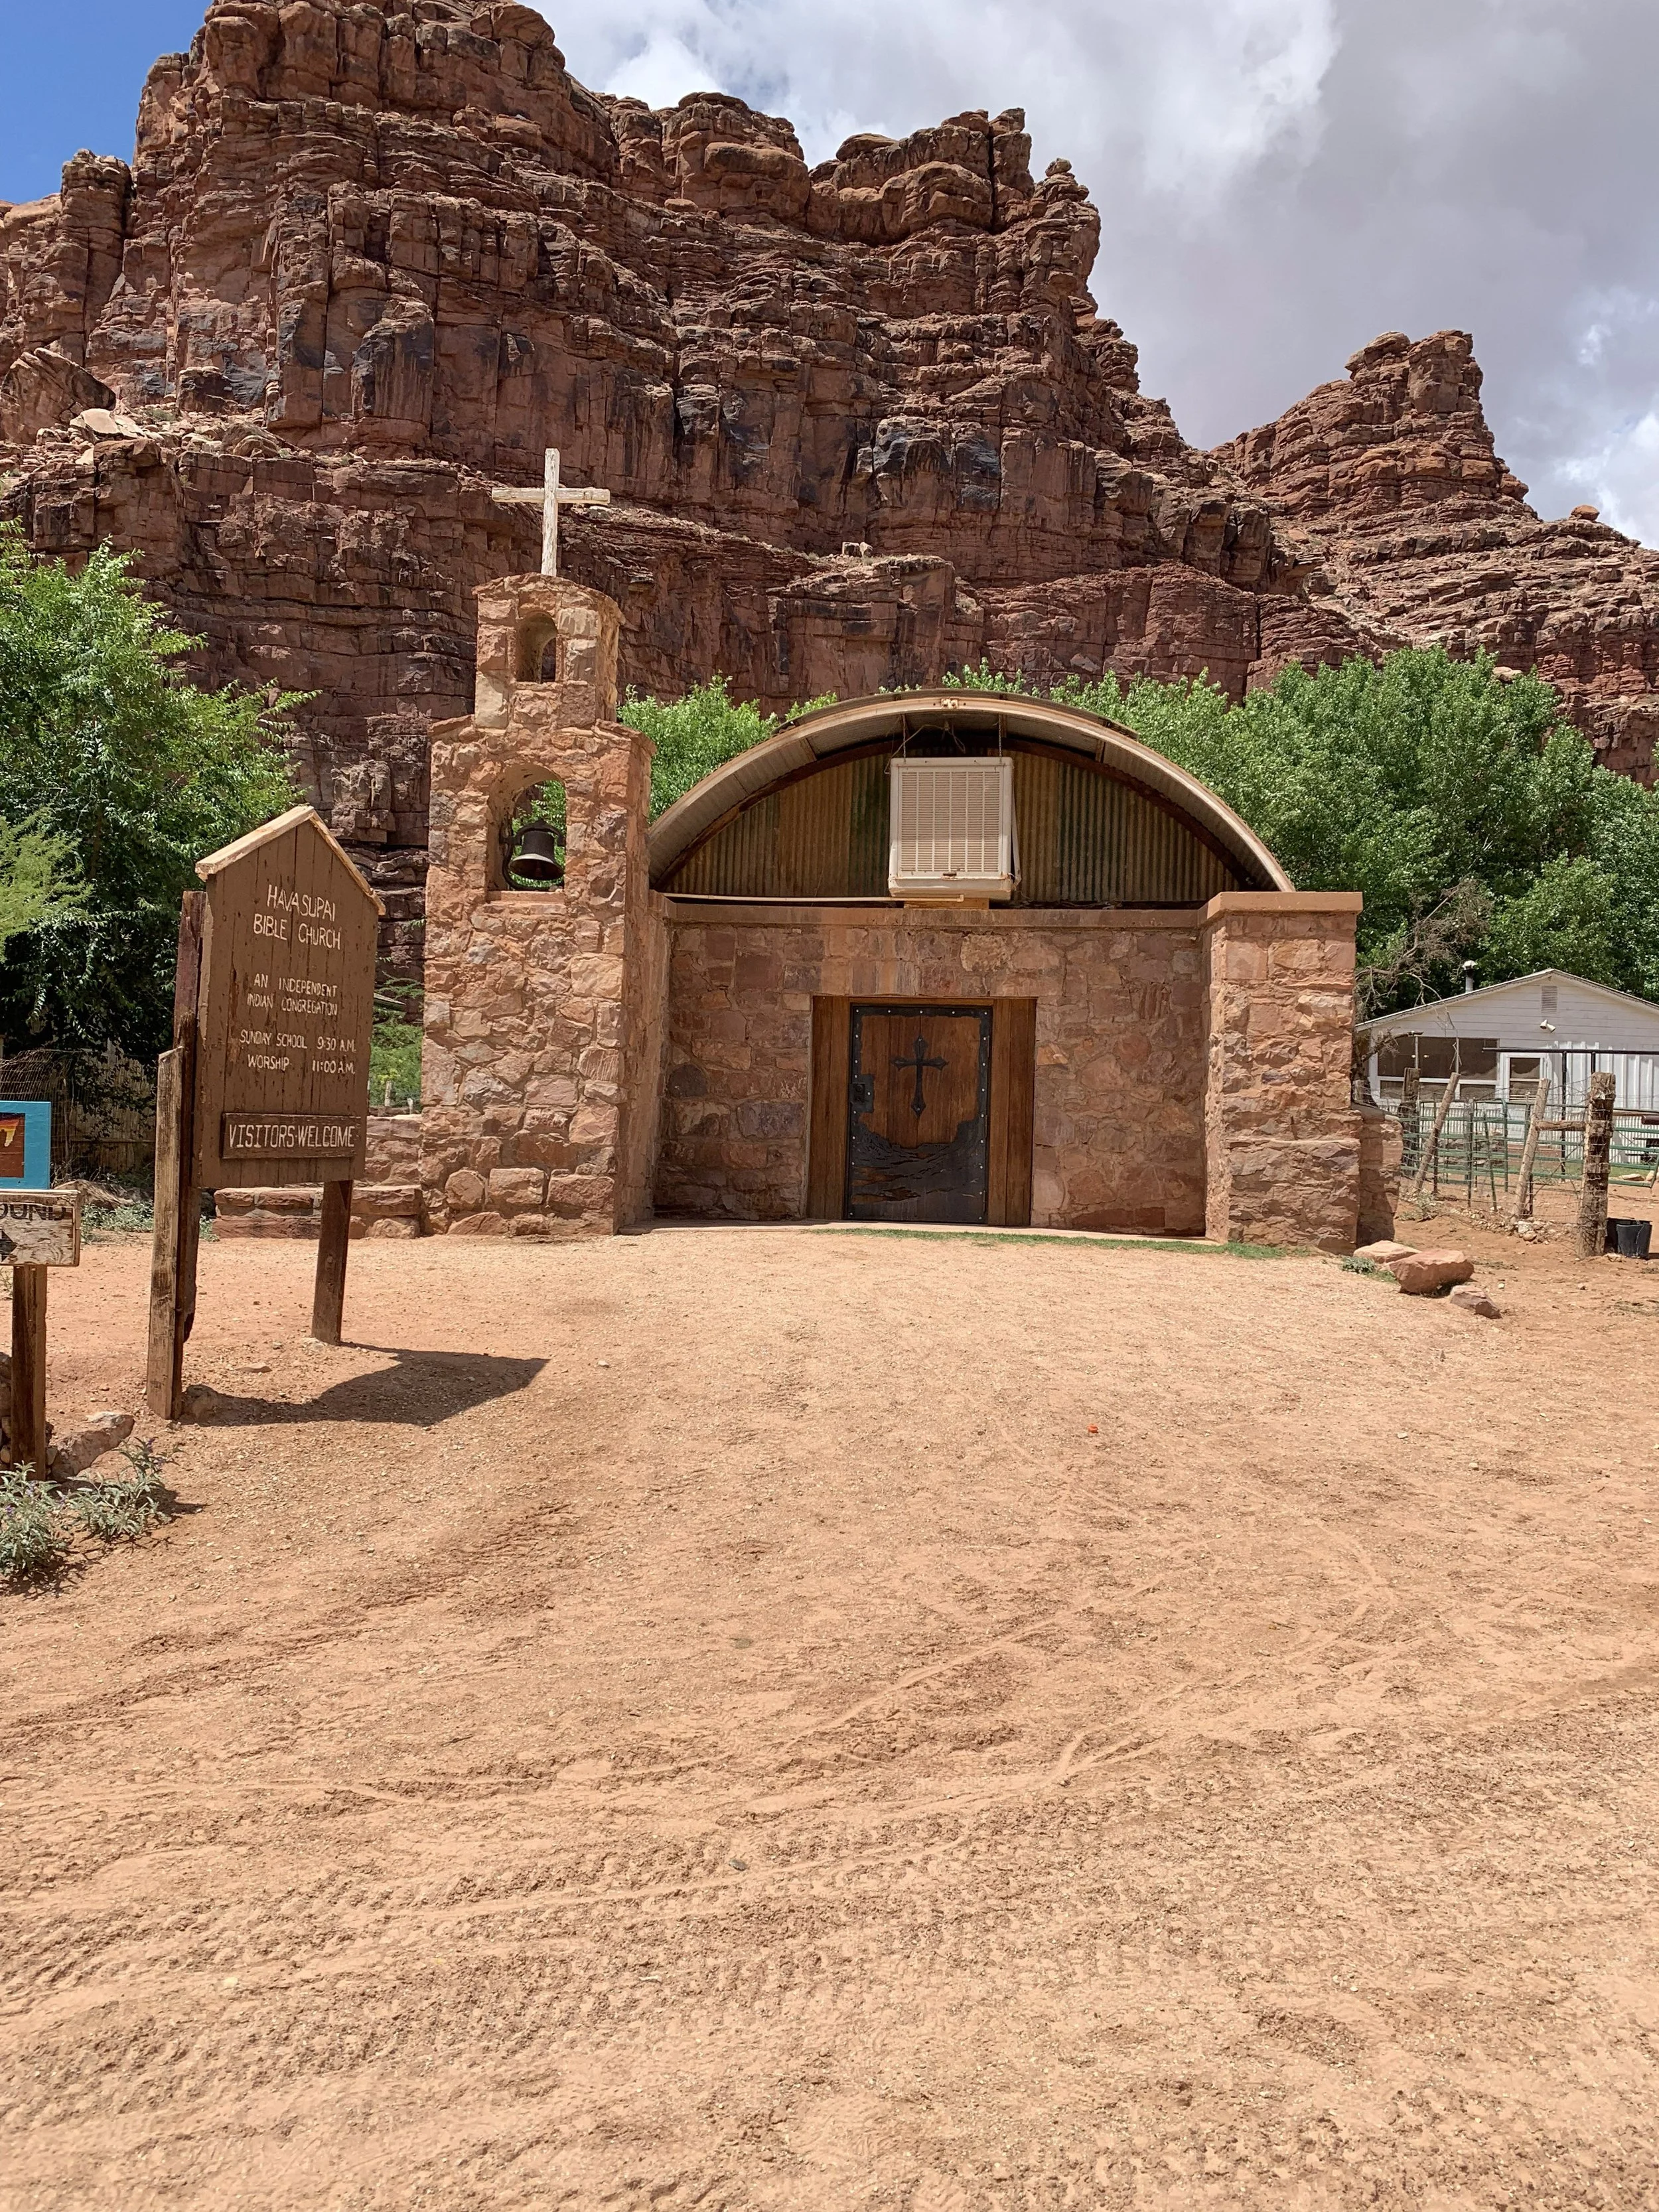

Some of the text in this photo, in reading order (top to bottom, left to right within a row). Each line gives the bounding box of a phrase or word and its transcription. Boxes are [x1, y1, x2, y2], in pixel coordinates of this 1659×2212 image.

[267, 884, 335, 922] HAVASUPAI
[253, 913, 340, 950] BIBLE CHURCH
[253, 973, 338, 997] AN INDEPENDENT
[247, 993, 338, 1015] INDIAN CONGREGATION
[239, 1029, 272, 1045] SUNDAY
[276, 1033, 307, 1049] SCHOOL
[248, 1054, 290, 1070] WORSHIP
